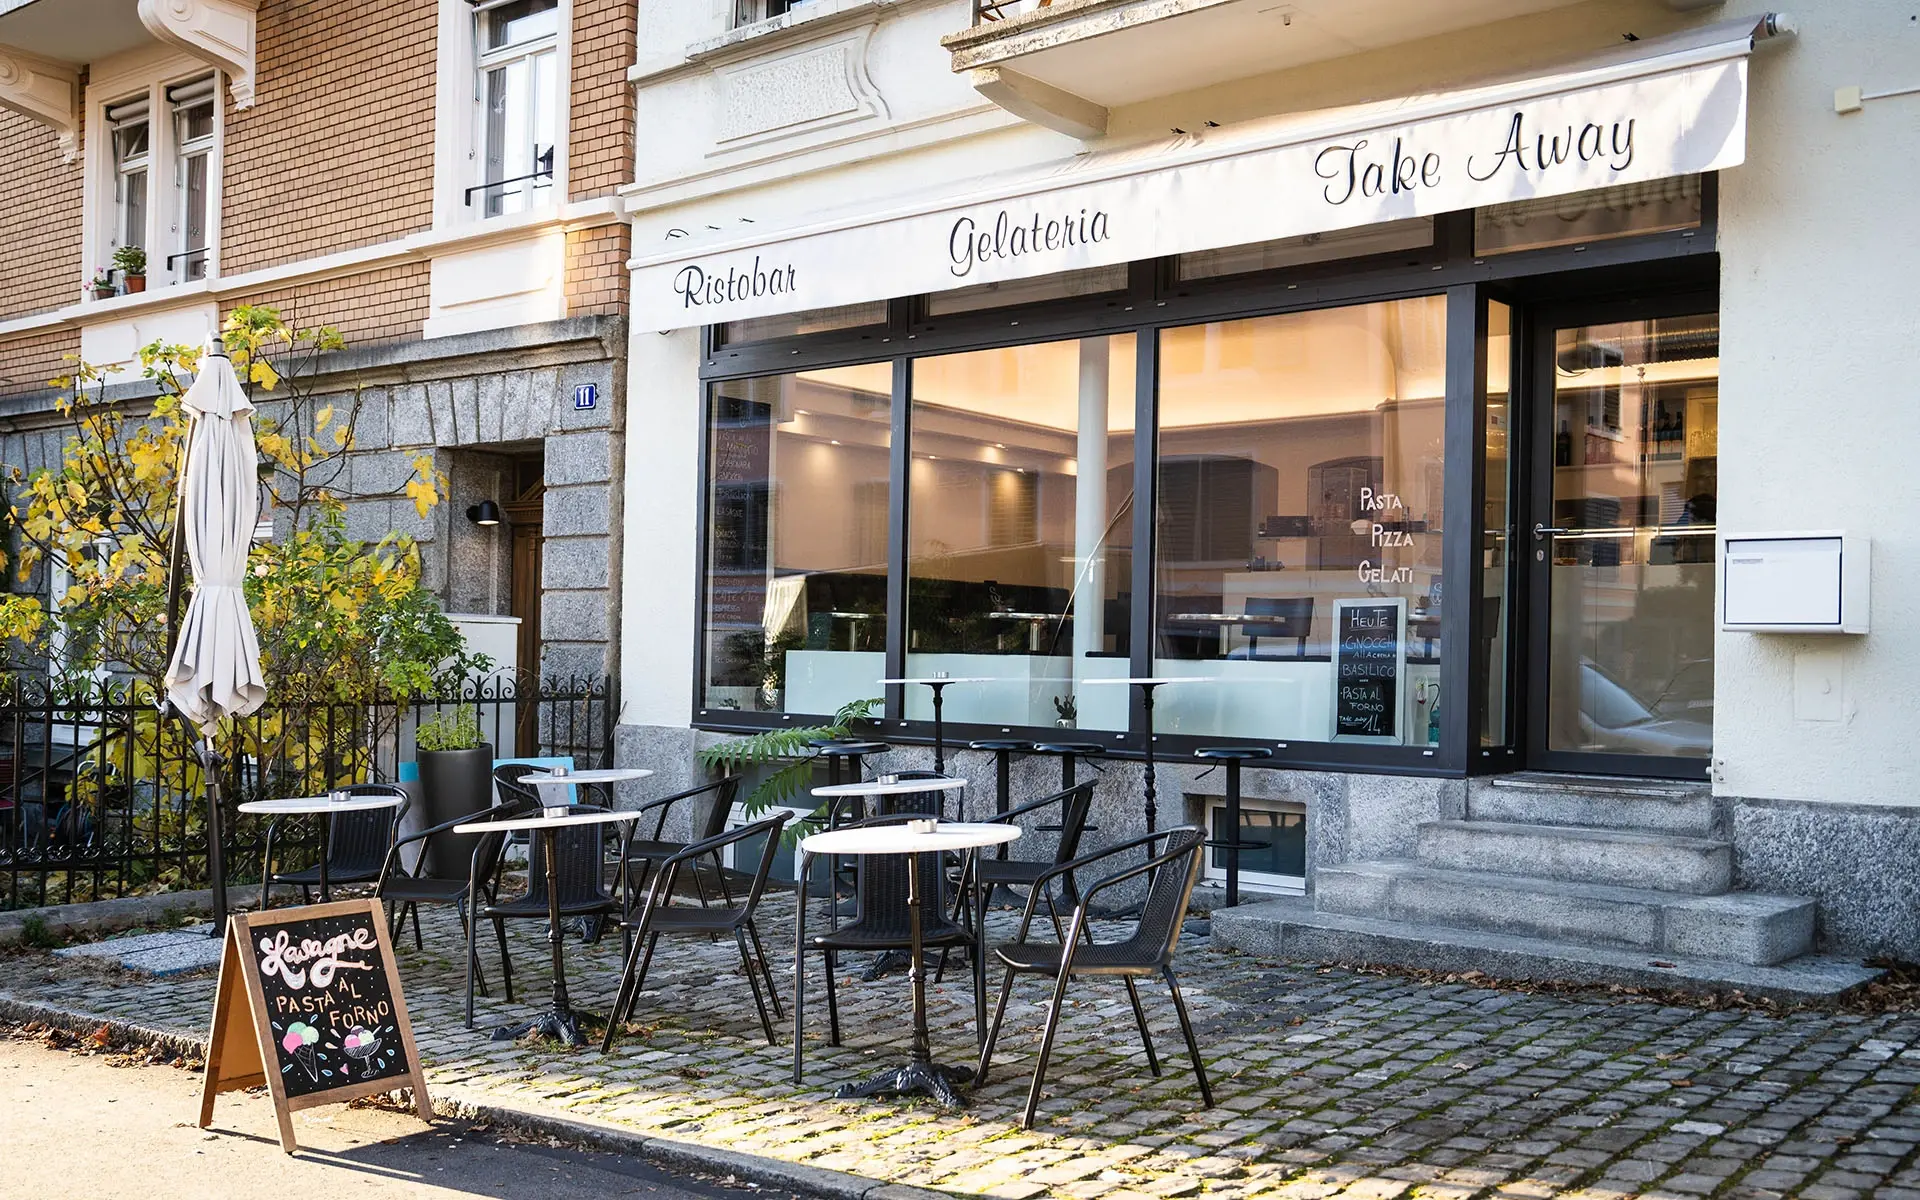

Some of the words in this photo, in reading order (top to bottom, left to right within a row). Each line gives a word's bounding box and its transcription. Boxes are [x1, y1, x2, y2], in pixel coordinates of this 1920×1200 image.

[1314, 137, 1441, 206] Take
[1467, 112, 1636, 182] Away
[949, 209, 1111, 277] Gelateria
[674, 255, 797, 309] Ristobar
[580, 387, 590, 406] 11
[1360, 487, 1403, 511] PASTA
[1371, 523, 1415, 548] PIZZA
[1358, 560, 1413, 584] GELATI
[1351, 609, 1388, 628] HEUTE
[1342, 663, 1396, 677] BASILICO
[1342, 686, 1367, 700] PASTA
[1370, 686, 1381, 700] AL
[1349, 702, 1384, 712] FORNO
[259, 928, 378, 990] Lasagne
[275, 990, 335, 1014] PASTA
[338, 977, 362, 1000] AL
[329, 1000, 390, 1030] FORNO
